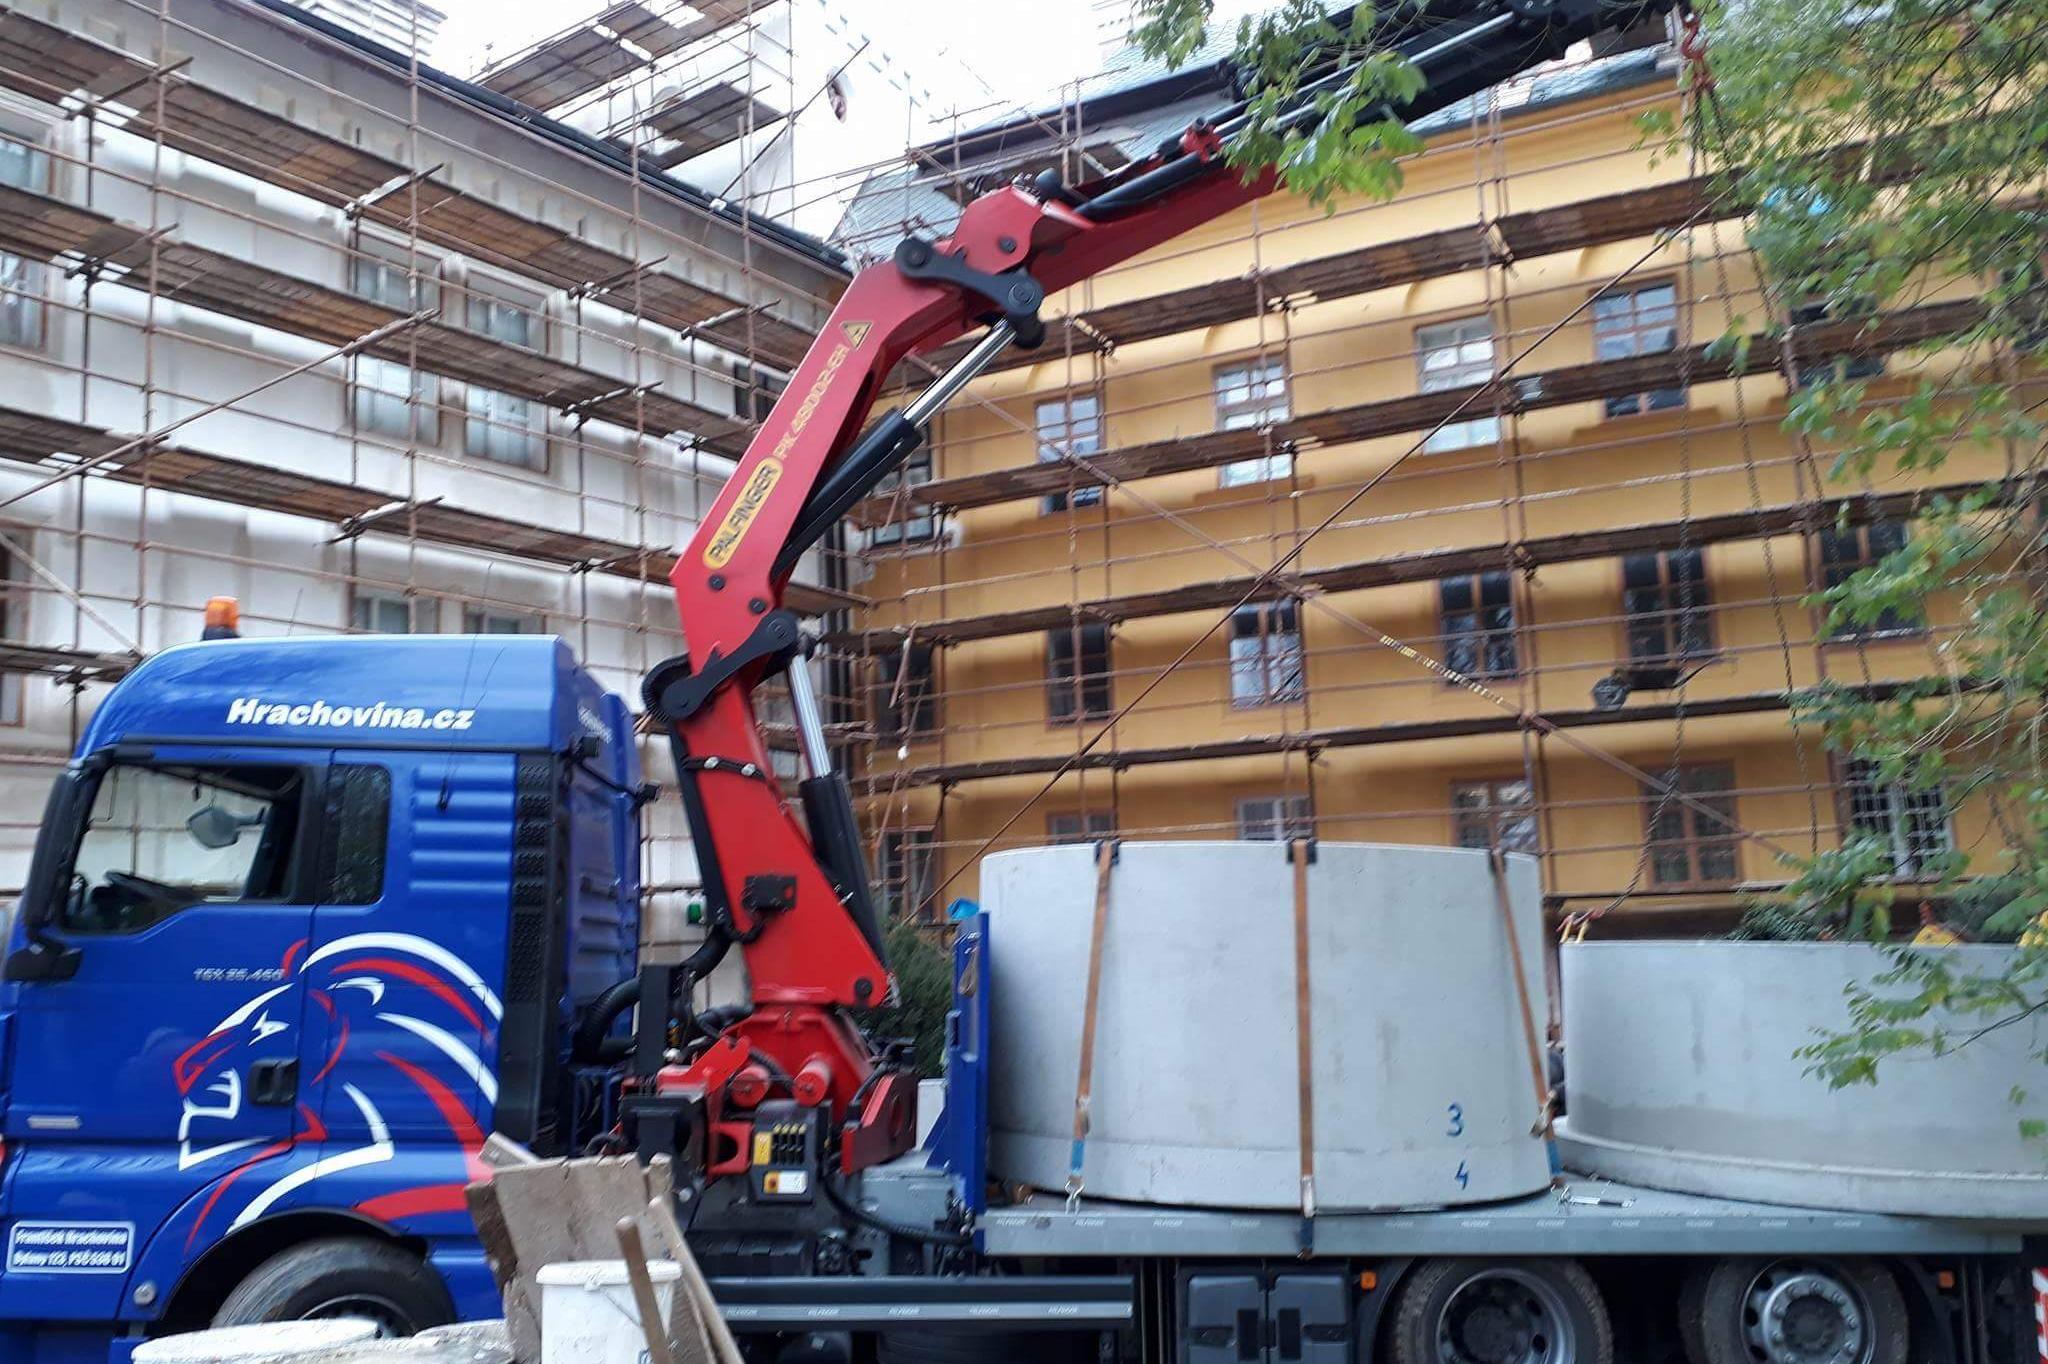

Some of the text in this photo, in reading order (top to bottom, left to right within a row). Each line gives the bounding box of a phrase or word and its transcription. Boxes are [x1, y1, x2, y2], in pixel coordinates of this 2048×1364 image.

[709, 465, 778, 561] PALFINGER
[1446, 1103, 1464, 1137] 3
[1454, 1160, 1470, 1190] 4
